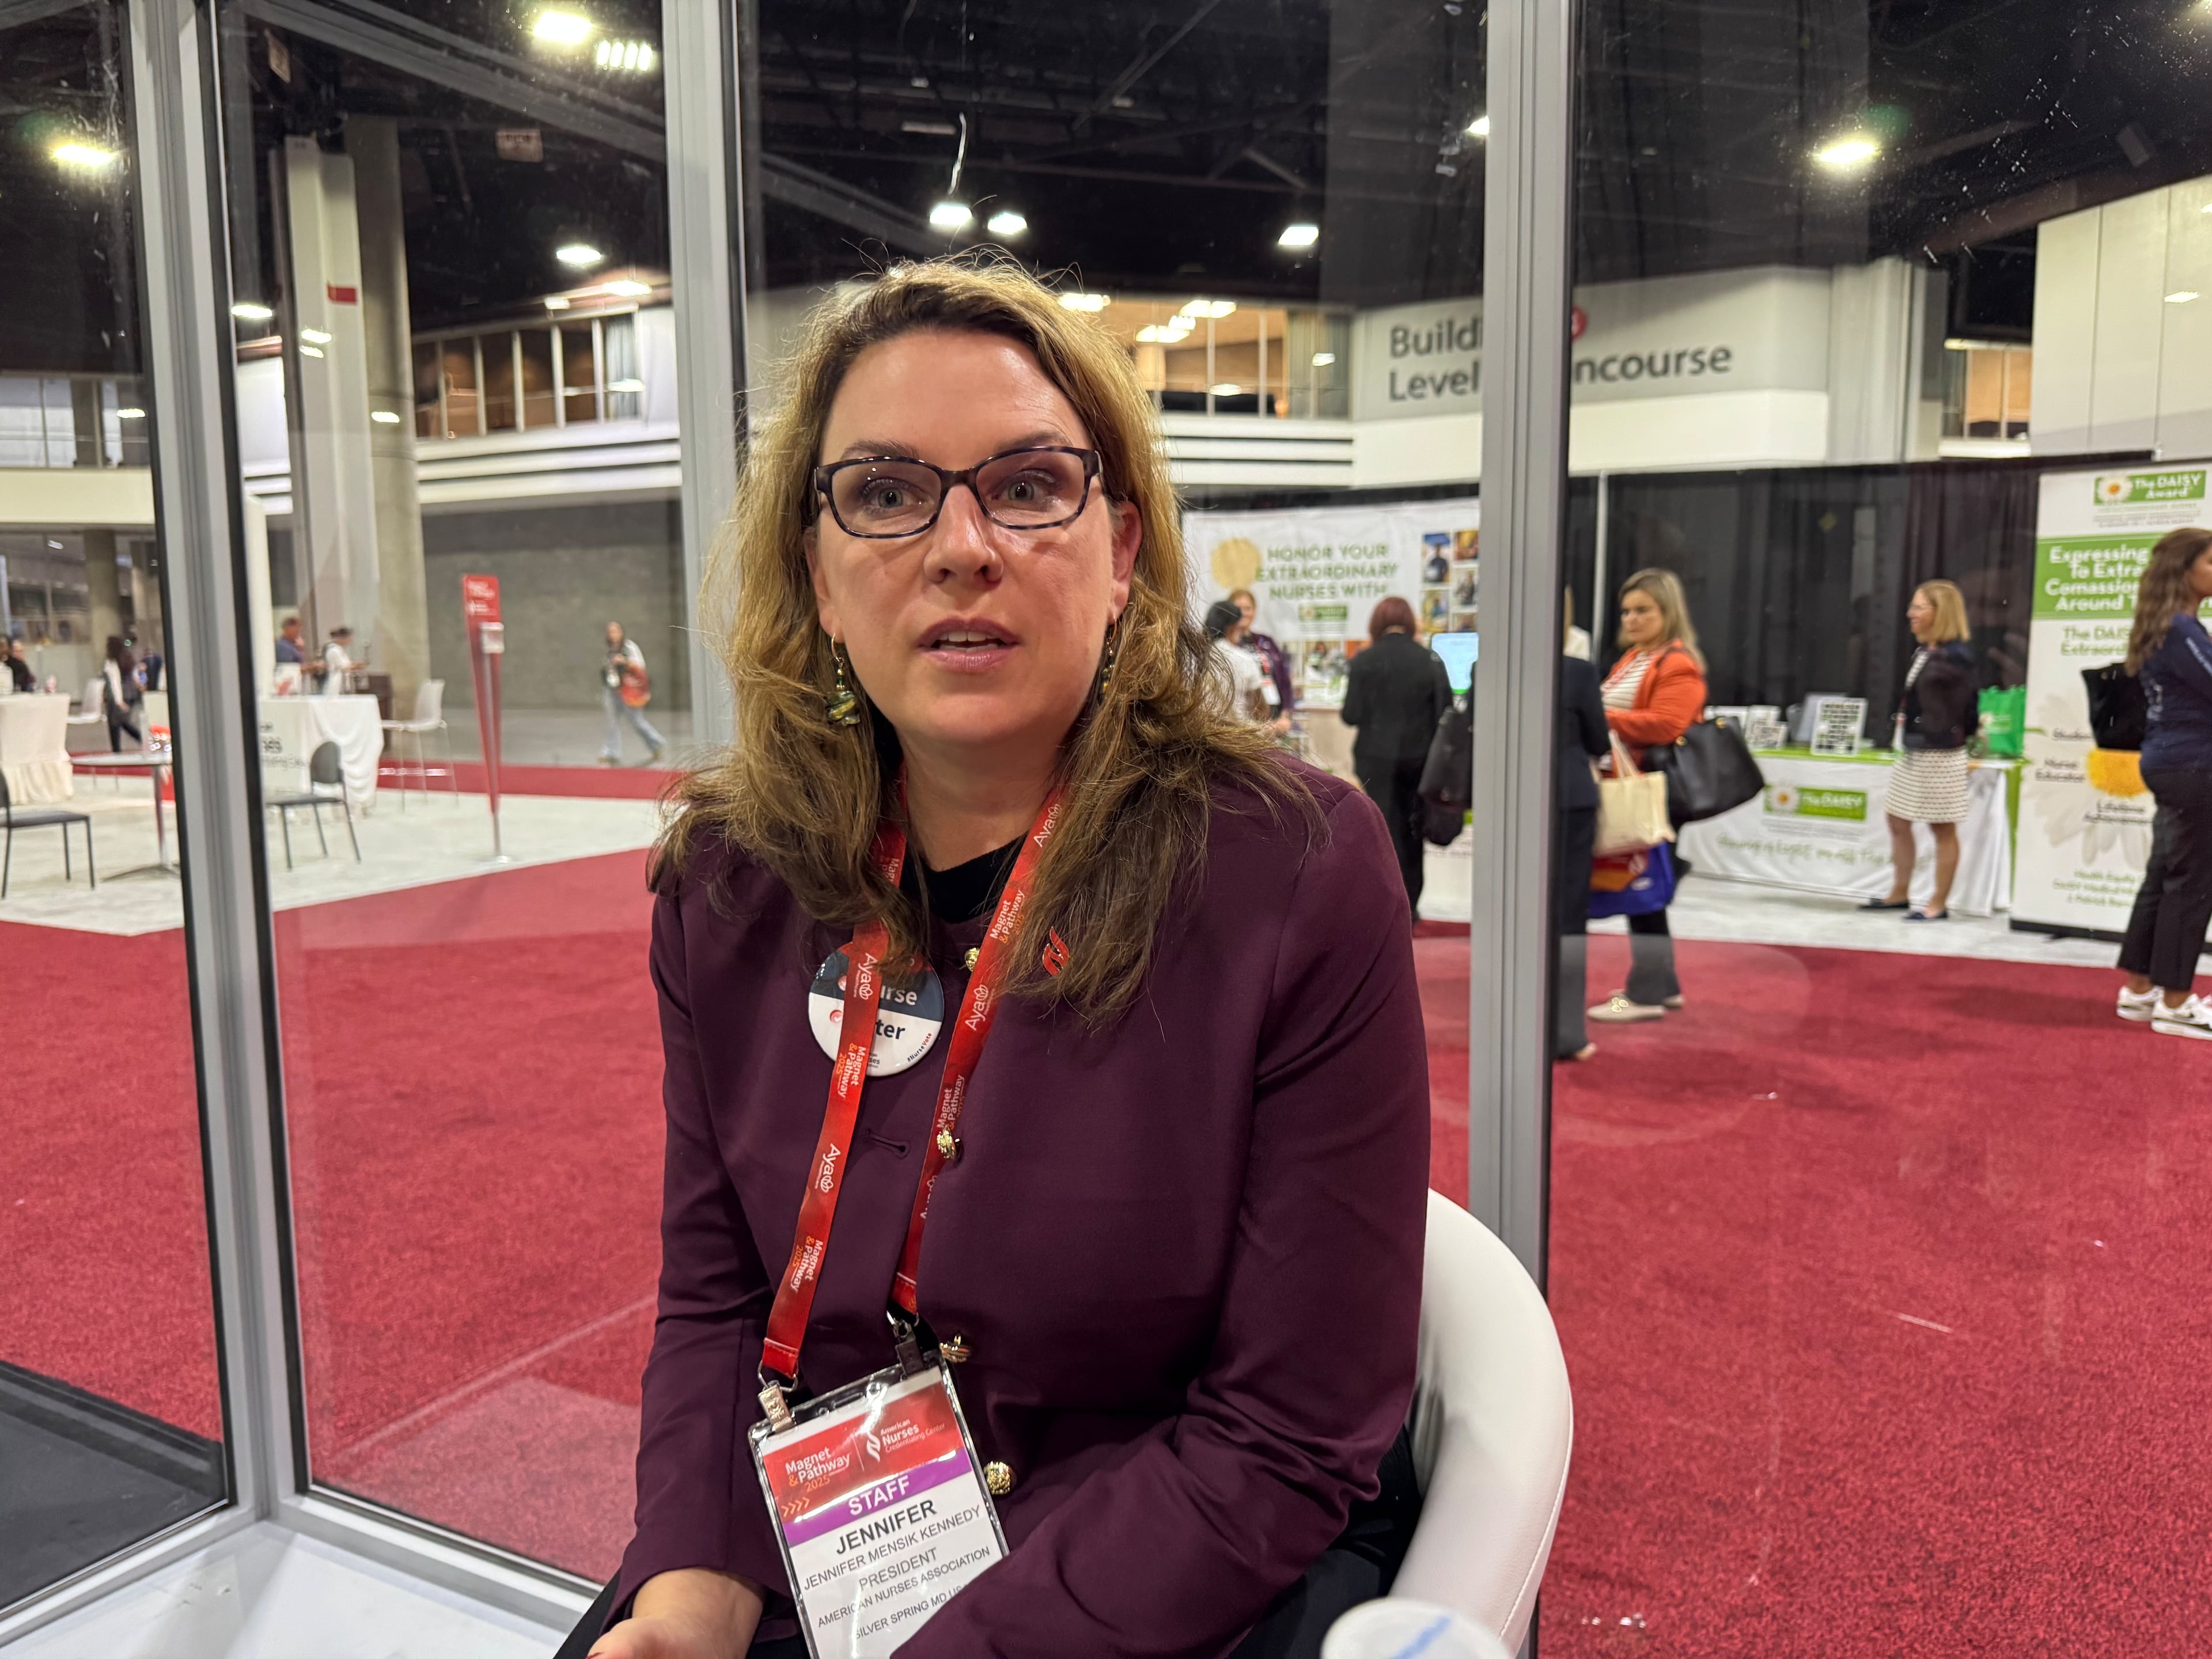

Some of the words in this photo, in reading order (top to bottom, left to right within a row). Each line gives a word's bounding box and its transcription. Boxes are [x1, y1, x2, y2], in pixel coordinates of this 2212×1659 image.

[1389, 359, 1480, 401] Level
[2146, 487, 2188, 499] Award
[2157, 474, 2202, 487] DAISY
[1268, 544, 1332, 561] HONOR
[1339, 543, 1389, 559] YOUR
[2050, 544, 2149, 564] Expressing
[2069, 562, 2090, 578] To
[1270, 583, 1336, 599] NURSES
[1341, 581, 1388, 597] WITH
[2055, 594, 2124, 611] Around
[990, 900, 1011, 939] Magnet
[858, 952, 878, 983] Aya
[965, 1001, 986, 1031] Aya
[836, 1052, 847, 1075] 2025
[851, 1046, 866, 1086] Magnet
[937, 1088, 952, 1128] Magnet
[823, 1143, 841, 1175] Aya
[793, 1245, 804, 1267] 2025
[805, 1240, 824, 1281] Magnet
[880, 1419, 910, 1435] American
[882, 1424, 919, 1446] Nurses
[885, 1430, 926, 1452] Credentialing
[925, 1423, 946, 1435] Center
[785, 1446, 831, 1475] Magnet
[805, 1475, 831, 1493] 2025
[849, 1475, 910, 1516] STAFF
[836, 1499, 937, 1555] JENNIFER
[805, 1555, 866, 1590] JENNIFER
[868, 1532, 919, 1563] MENSIK
[920, 1505, 980, 1541] KENNEDY
[859, 1547, 937, 1590] PRESIDENT
[819, 1593, 873, 1628] AMERICAN
[875, 1576, 919, 1603] NURSES
[921, 1546, 991, 1583] ASSOCIATION
[856, 1618, 889, 1639] SILVER
[890, 1600, 929, 1624] SPRING
[931, 1592, 947, 1607] MD
